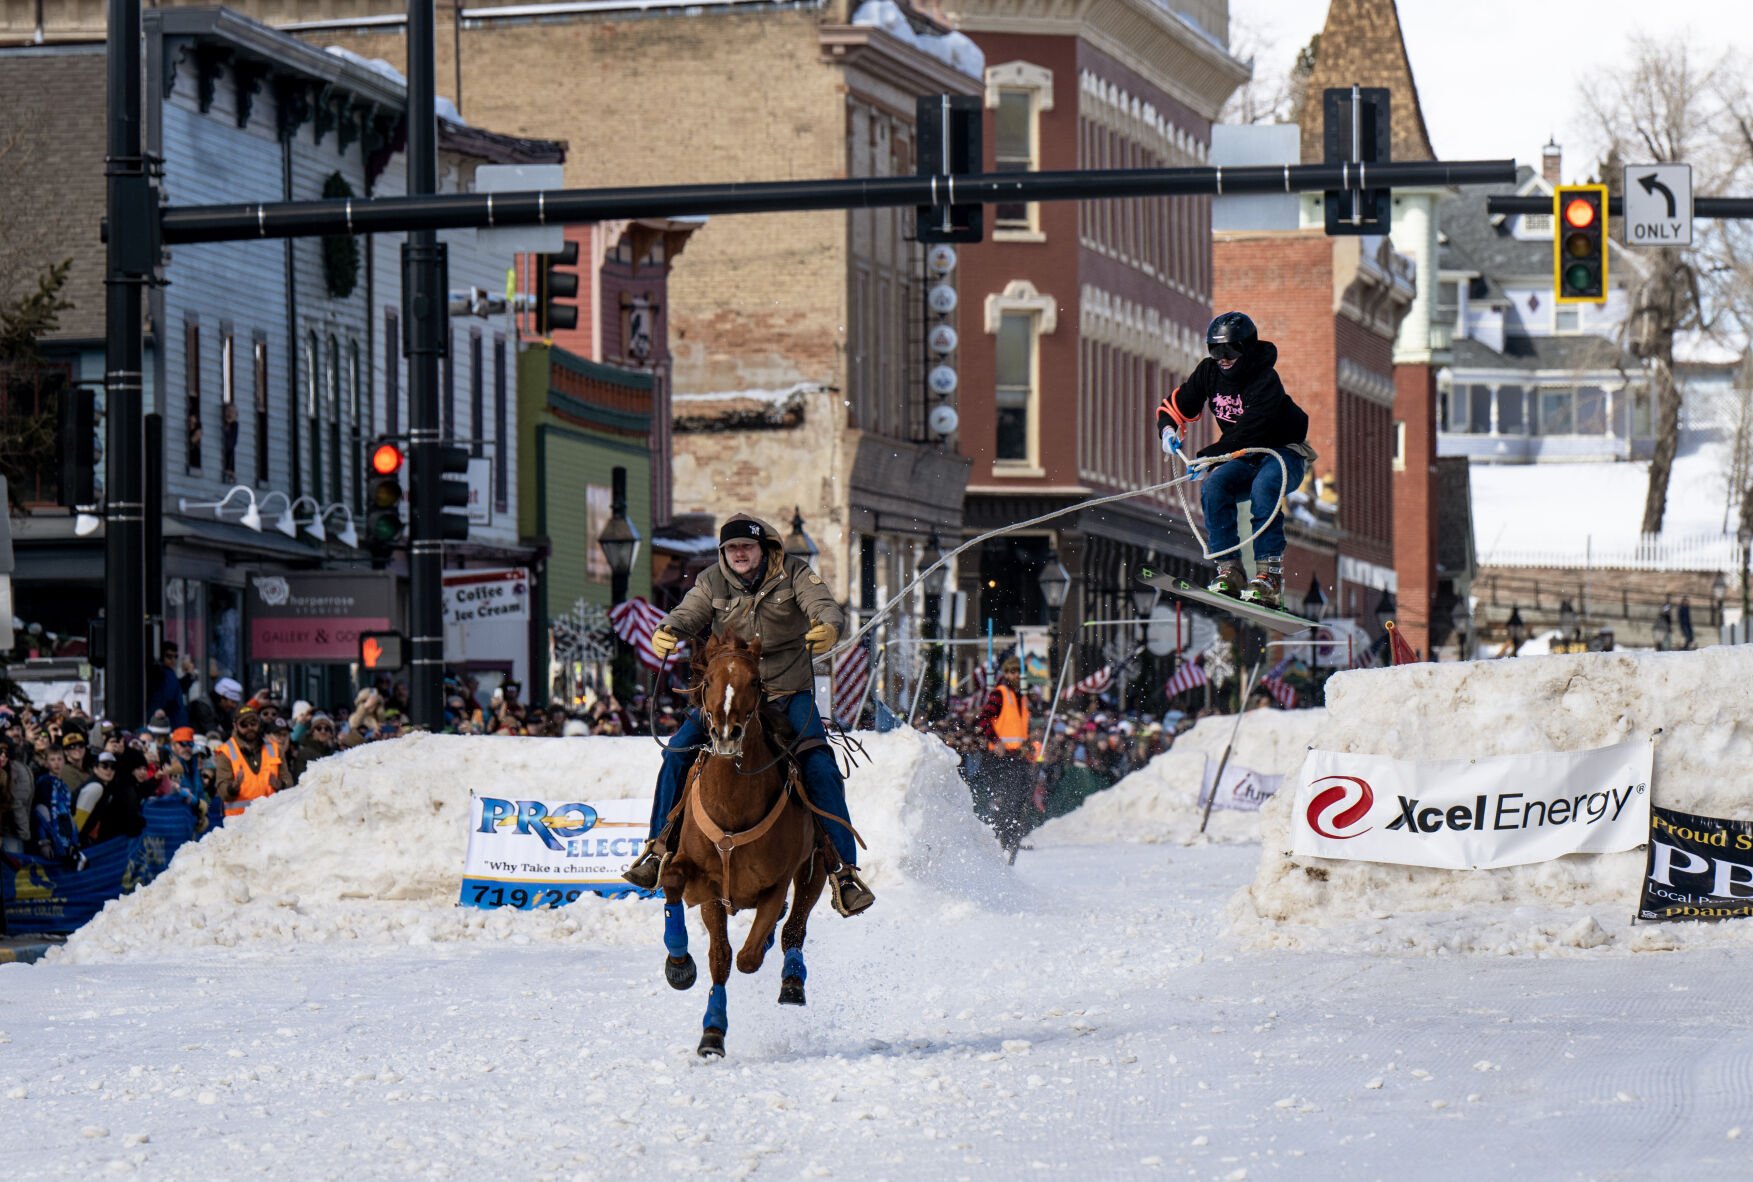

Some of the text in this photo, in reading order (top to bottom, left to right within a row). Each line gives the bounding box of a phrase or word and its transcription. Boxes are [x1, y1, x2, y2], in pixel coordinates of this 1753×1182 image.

[1634, 223, 1682, 239] ONLY
[290, 595, 354, 606] harperrose
[456, 586, 503, 603] Coffee
[455, 603, 520, 621] Ice Cream
[262, 631, 310, 643] GALLERY
[316, 628, 330, 645] &
[1385, 795, 1487, 834] Xcel
[476, 797, 597, 851] PRO
[1652, 815, 1727, 847] Proud
[521, 862, 550, 873] Take
[553, 864, 560, 874] a
[563, 863, 617, 874] chance...
[472, 886, 528, 909] 719
[1649, 882, 1692, 904] Local
